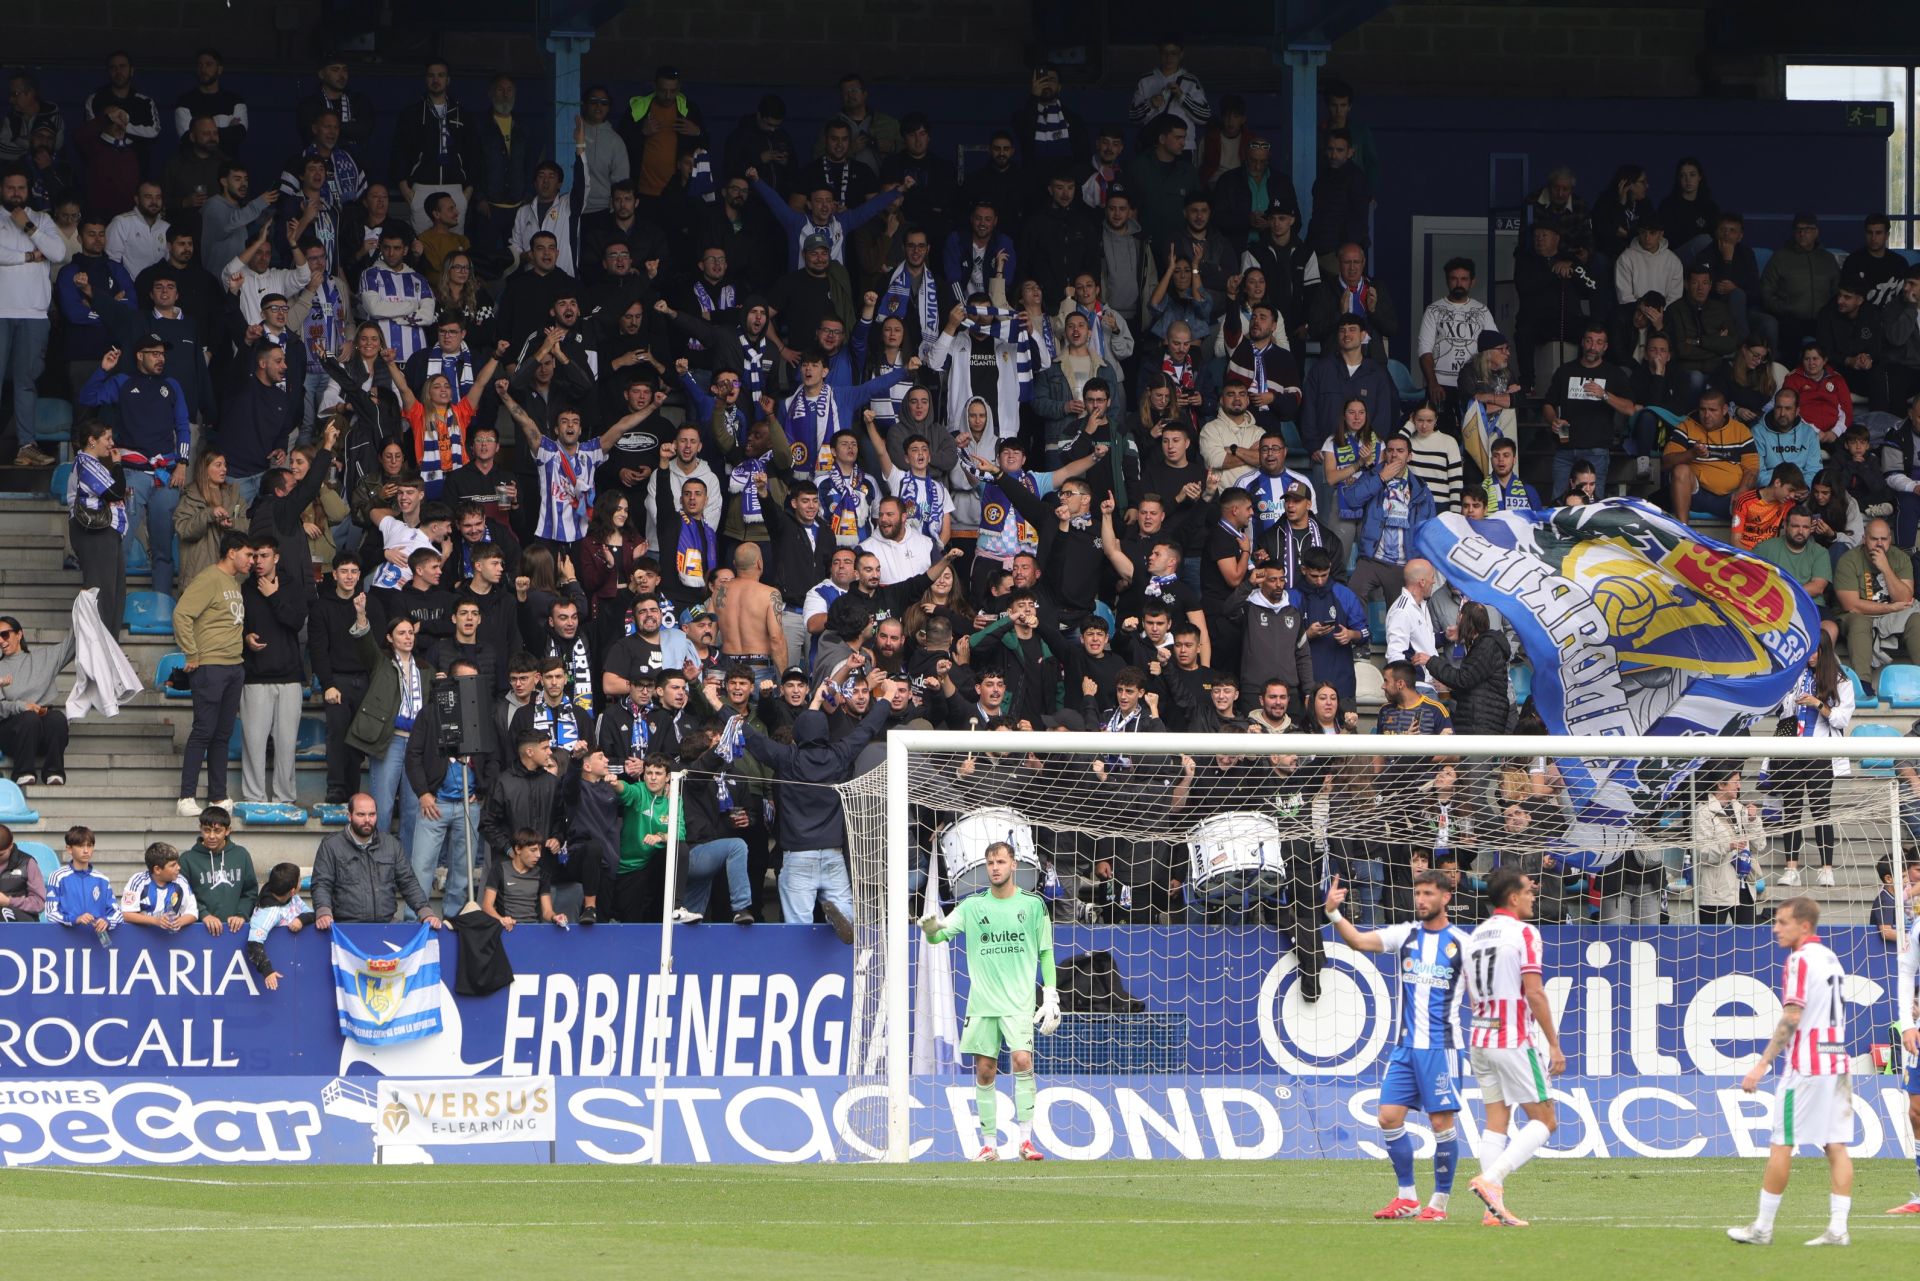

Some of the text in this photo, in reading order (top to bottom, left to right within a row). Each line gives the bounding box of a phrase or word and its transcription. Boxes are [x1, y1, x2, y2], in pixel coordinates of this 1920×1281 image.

[980, 946, 1025, 956] CRICURSA
[0, 1088, 101, 1104] IONES
[414, 1088, 549, 1118] VERSUS
[432, 1118, 537, 1133] E-LEARNING
